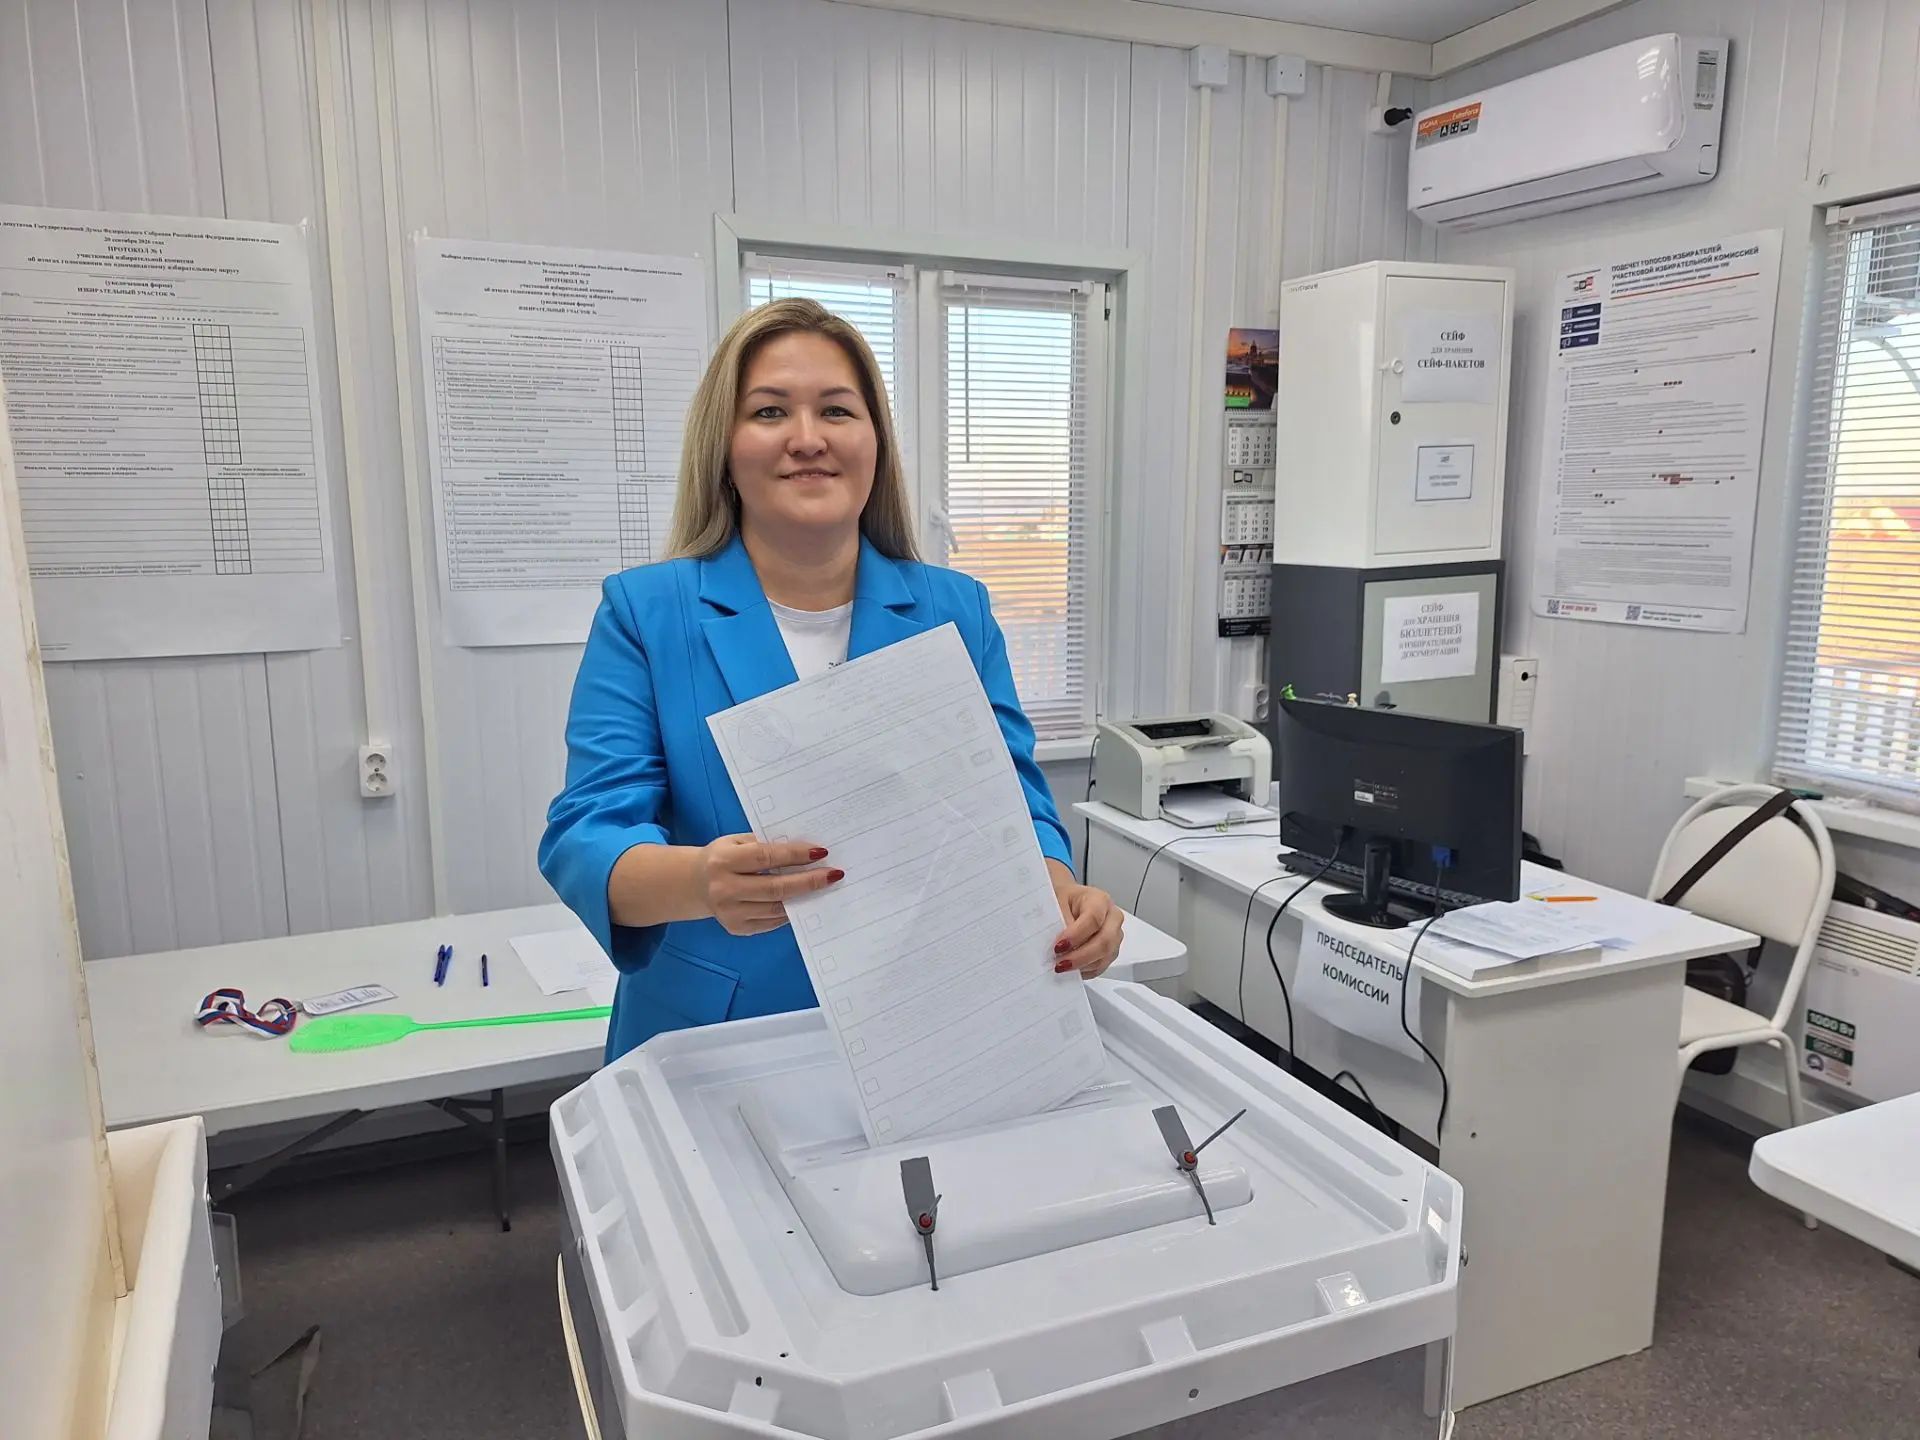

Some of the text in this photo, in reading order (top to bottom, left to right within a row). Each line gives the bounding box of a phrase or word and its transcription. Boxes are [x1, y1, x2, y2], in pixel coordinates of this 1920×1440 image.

[1611, 244, 1722, 272] ПОДСЧЕТ ГОЛОСОВ ИЗБИРАТЕЛЕЙ
[1612, 265, 1654, 280] УЧАСТКОВОЙ
[1655, 256, 1712, 273] ИЗБИРАТЕЛЬНОЙ
[1714, 246, 1760, 262] КОМИССИЕЙ
[1440, 330, 1466, 341] СЕЙФ
[1418, 357, 1485, 368] СЕЙФ-ПАКЕТОВ
[1421, 602, 1444, 614] СЕЙФ
[1417, 614, 1460, 624] ХРАНЕНИЯ
[1400, 624, 1462, 639] БЮЛЛЕТЕНЕЙ
[1401, 647, 1460, 660] ДОКУМЕНТАЦИИ
[1316, 931, 1403, 981] ПРЕДСЕДАТЕЛЬ
[1322, 962, 1390, 1005] КОМИССИИ
